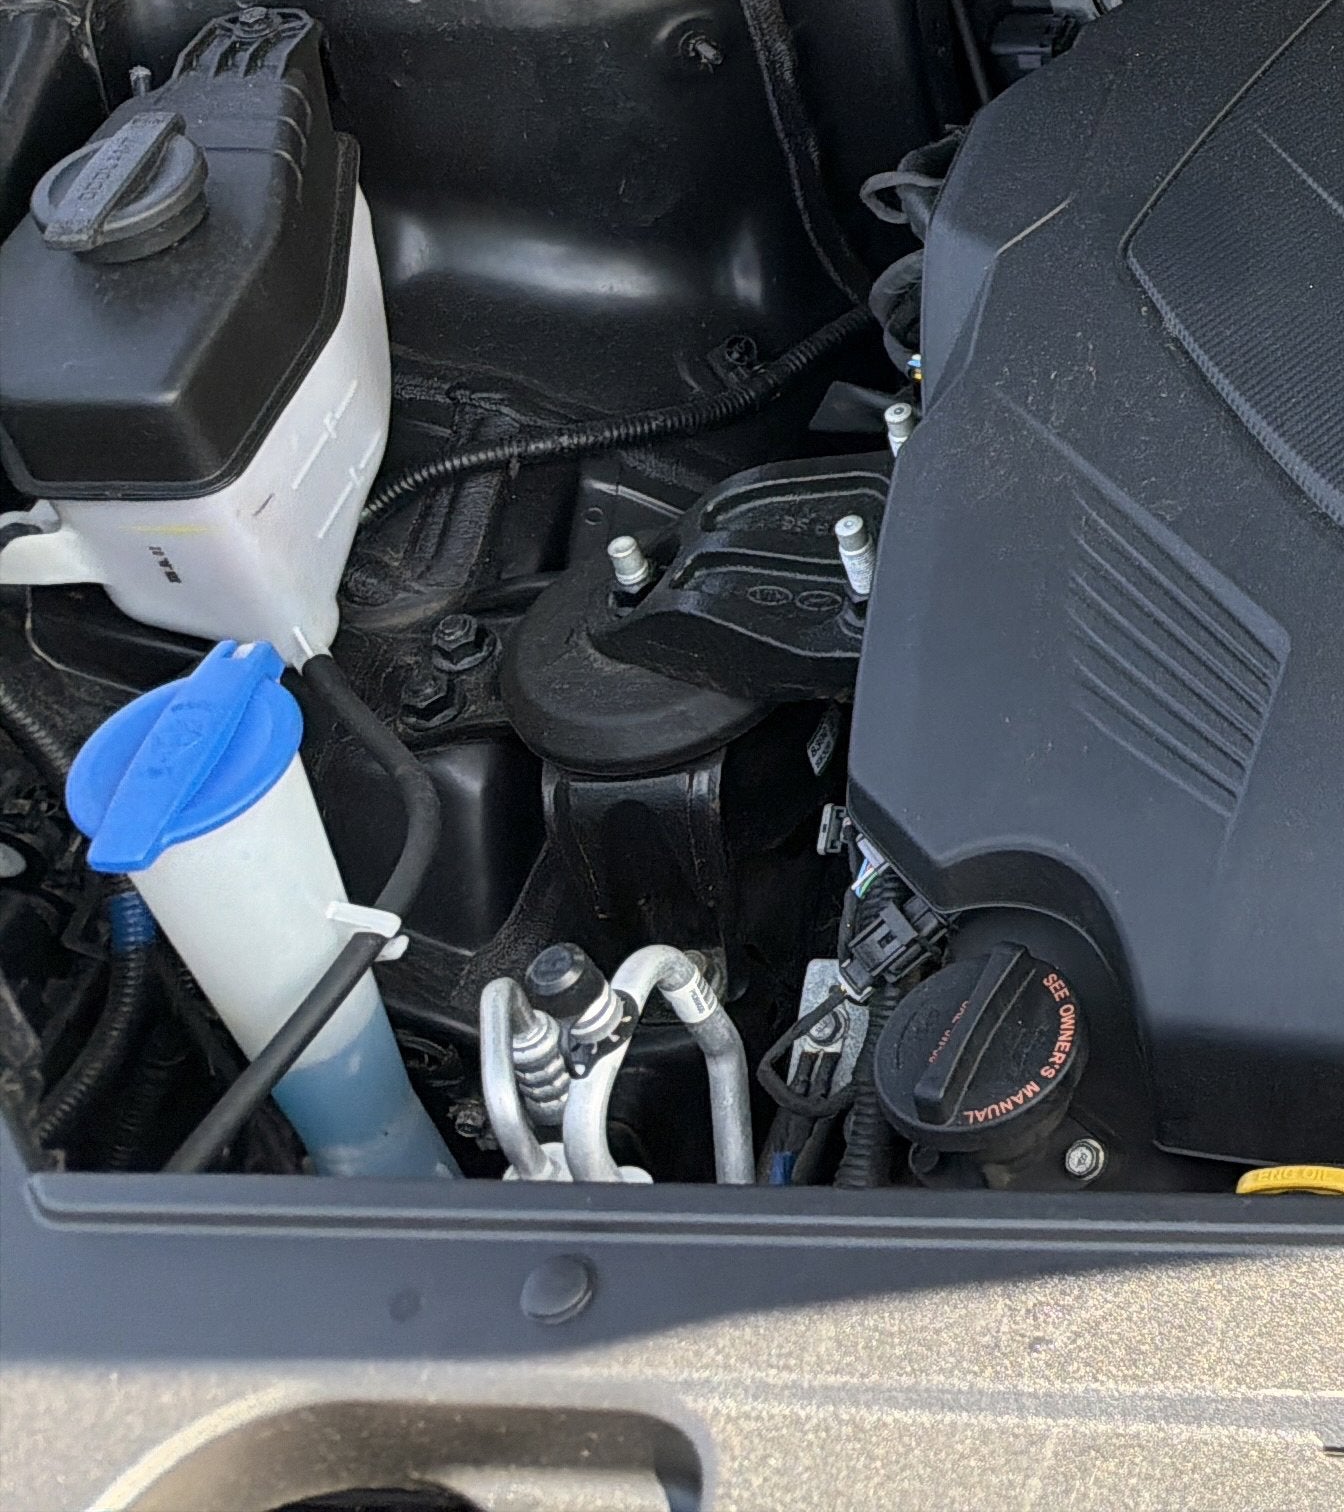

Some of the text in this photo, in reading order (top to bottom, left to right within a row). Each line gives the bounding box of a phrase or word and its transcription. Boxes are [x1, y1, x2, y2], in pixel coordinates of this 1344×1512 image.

[963, 972, 1078, 1125] SEE OWNER'S MANUAL
